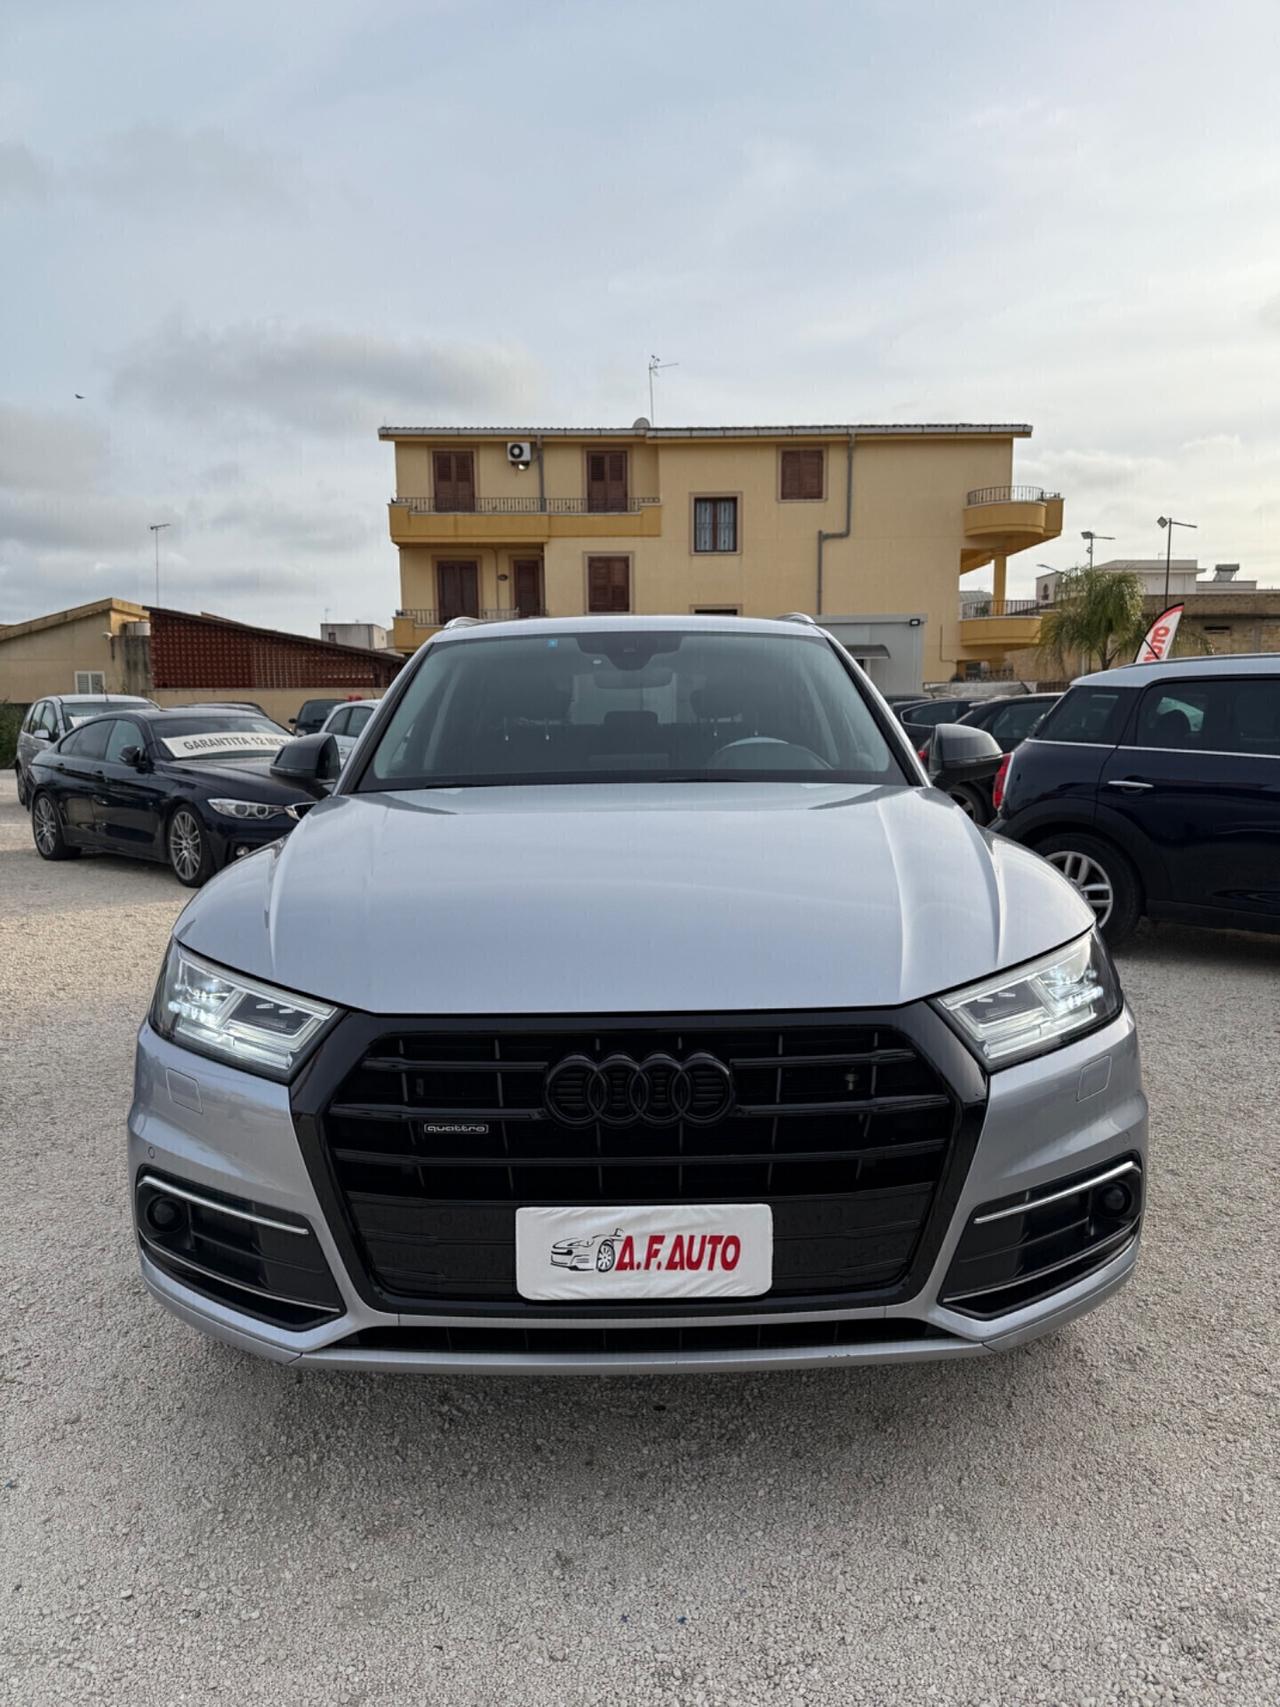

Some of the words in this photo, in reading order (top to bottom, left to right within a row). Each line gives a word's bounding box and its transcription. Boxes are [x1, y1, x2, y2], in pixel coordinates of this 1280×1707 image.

[183, 737, 251, 751] GARANTITA
[251, 737, 266, 746] 12
[427, 1125, 485, 1133] quattro
